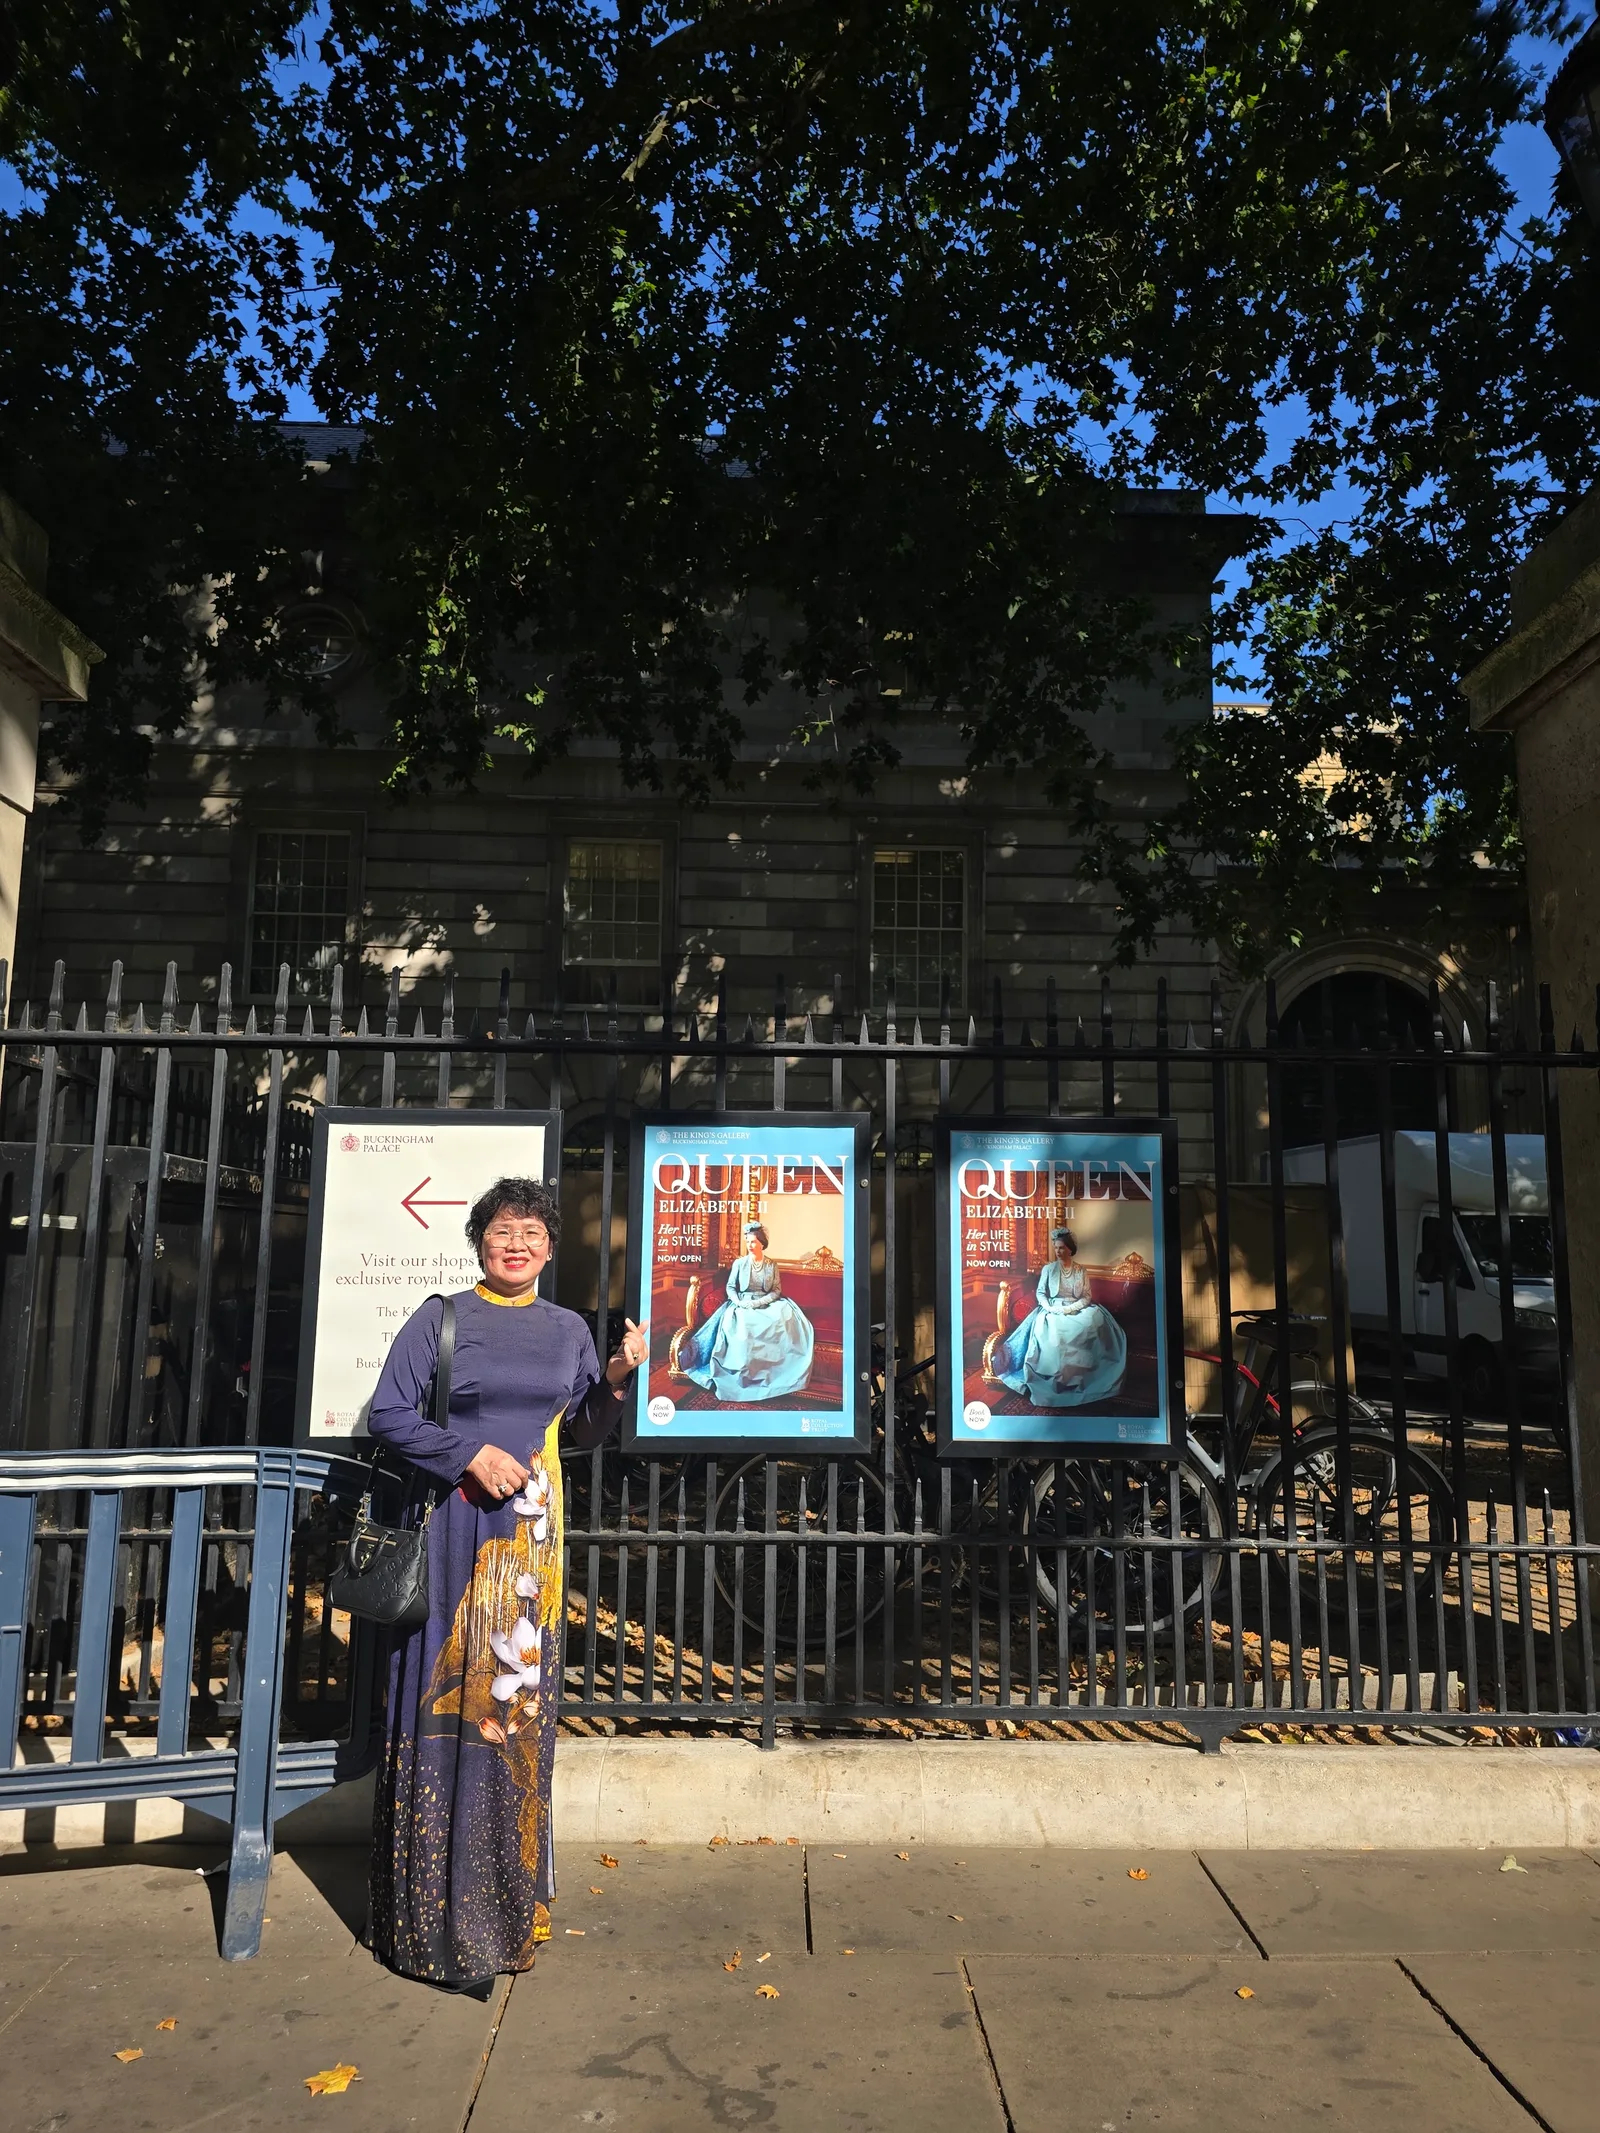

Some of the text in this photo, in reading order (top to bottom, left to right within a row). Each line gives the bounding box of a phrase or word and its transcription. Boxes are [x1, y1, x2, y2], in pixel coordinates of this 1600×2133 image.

[363, 1135, 434, 1143] BUCKINGHAM
[673, 1131, 750, 1140] THE KING'S GALLERY
[1021, 1137, 1055, 1145] GALLERY
[363, 1144, 401, 1152] PALACE
[652, 1153, 849, 1195] QUEEN
[957, 1158, 1156, 1201] QUEEN
[659, 1200, 768, 1214] ELIZABETH II
[966, 1205, 1076, 1219] ELIZABETH II
[657, 1224, 703, 1235] Her LIFE
[966, 1229, 1010, 1240] Her LIFE
[657, 1235, 702, 1246] in STYLE
[966, 1240, 1010, 1251] in STYLE
[360, 1253, 475, 1270] Visit our shops
[657, 1255, 702, 1263] NOW OPEN
[966, 1260, 1010, 1268] NOW OPEN
[335, 1271, 402, 1285] exclusive
[408, 1271, 443, 1288] royal
[375, 1306, 398, 1317] The
